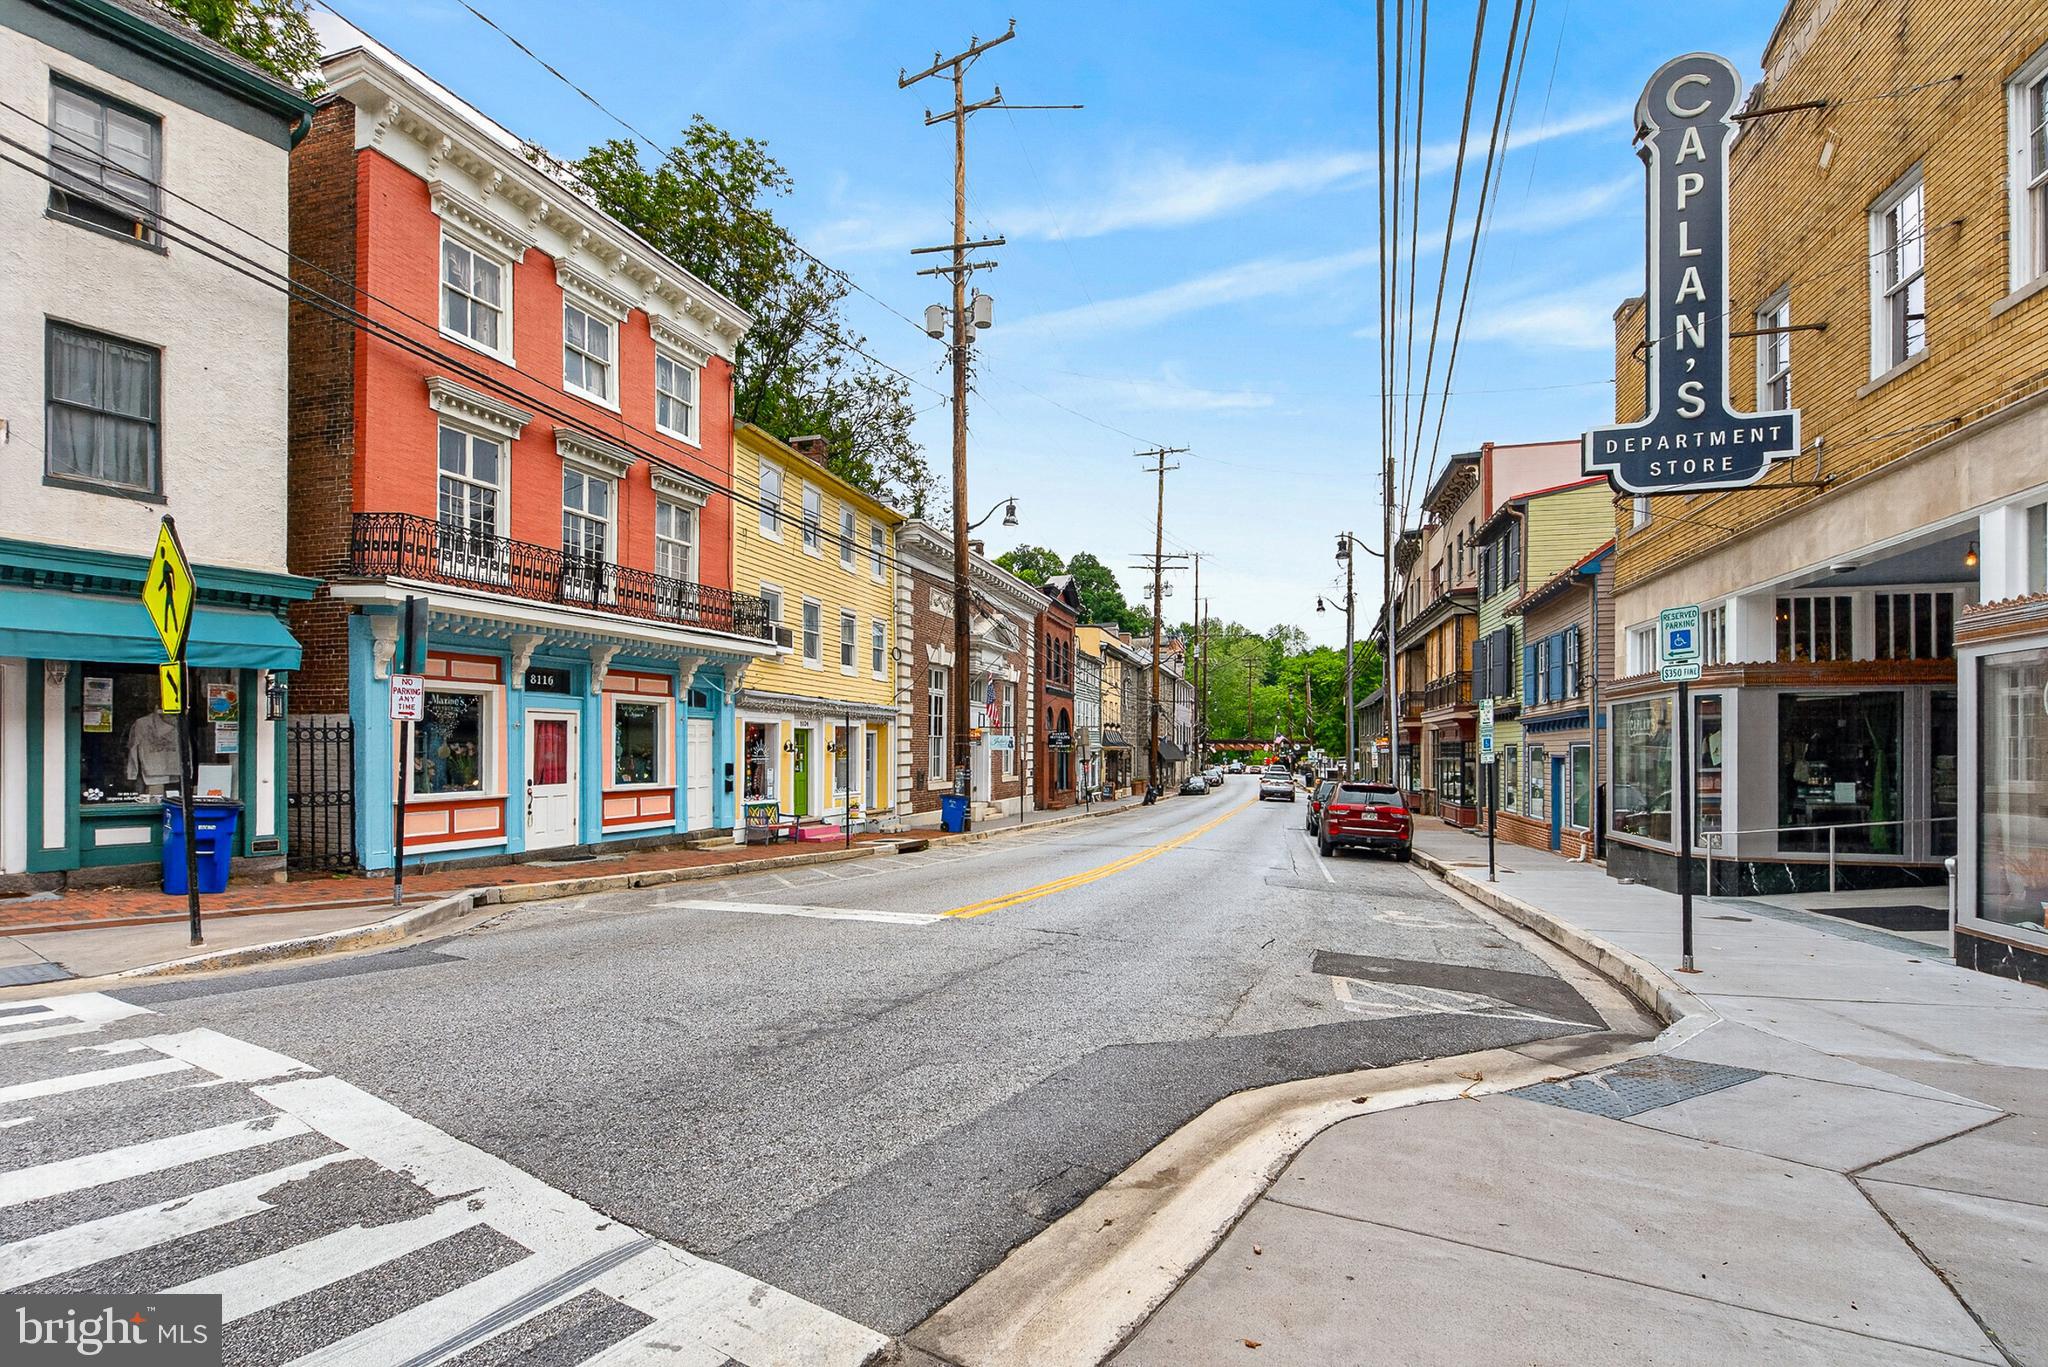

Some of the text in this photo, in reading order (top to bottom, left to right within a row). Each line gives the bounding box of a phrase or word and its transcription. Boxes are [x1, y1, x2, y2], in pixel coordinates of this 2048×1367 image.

[1665, 73, 1712, 420] CAPLAN'S
[1606, 426, 1781, 454] DEPARTMENT
[1650, 456, 1733, 477] STORE
[1663, 609, 1697, 621] RESERVED
[1665, 619, 1695, 630] PARKING
[1664, 668, 1682, 678] $350
[1684, 667, 1697, 676] FINE
[401, 678, 413, 686] NO
[530, 674, 554, 686] 8116
[392, 686, 421, 696] PARKING
